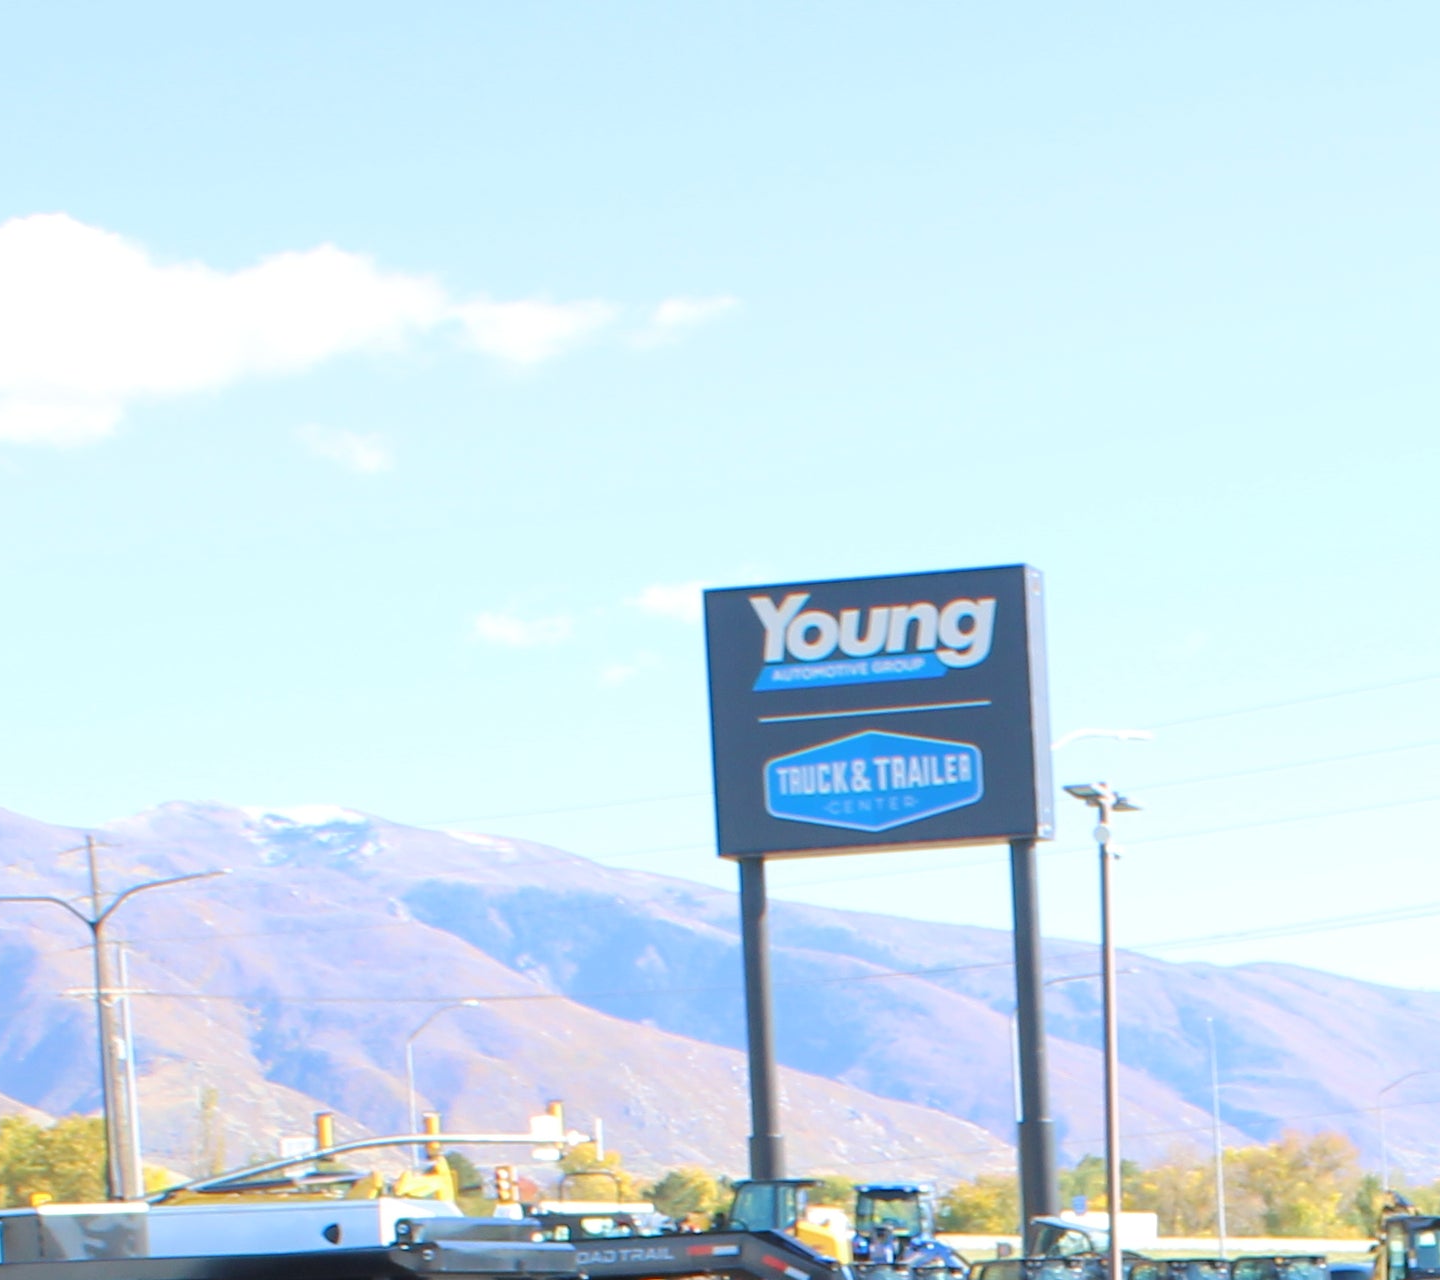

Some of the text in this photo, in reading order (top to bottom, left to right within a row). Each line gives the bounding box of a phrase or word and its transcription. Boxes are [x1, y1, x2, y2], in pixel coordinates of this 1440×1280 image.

[749, 593, 996, 668] Young
[771, 656, 926, 681] AUTOMOTIVE GROUP
[776, 753, 972, 795] TRUCK & TRAILER
[827, 796, 916, 815] CENTER
[576, 1247, 675, 1266] OAD TRAIL
